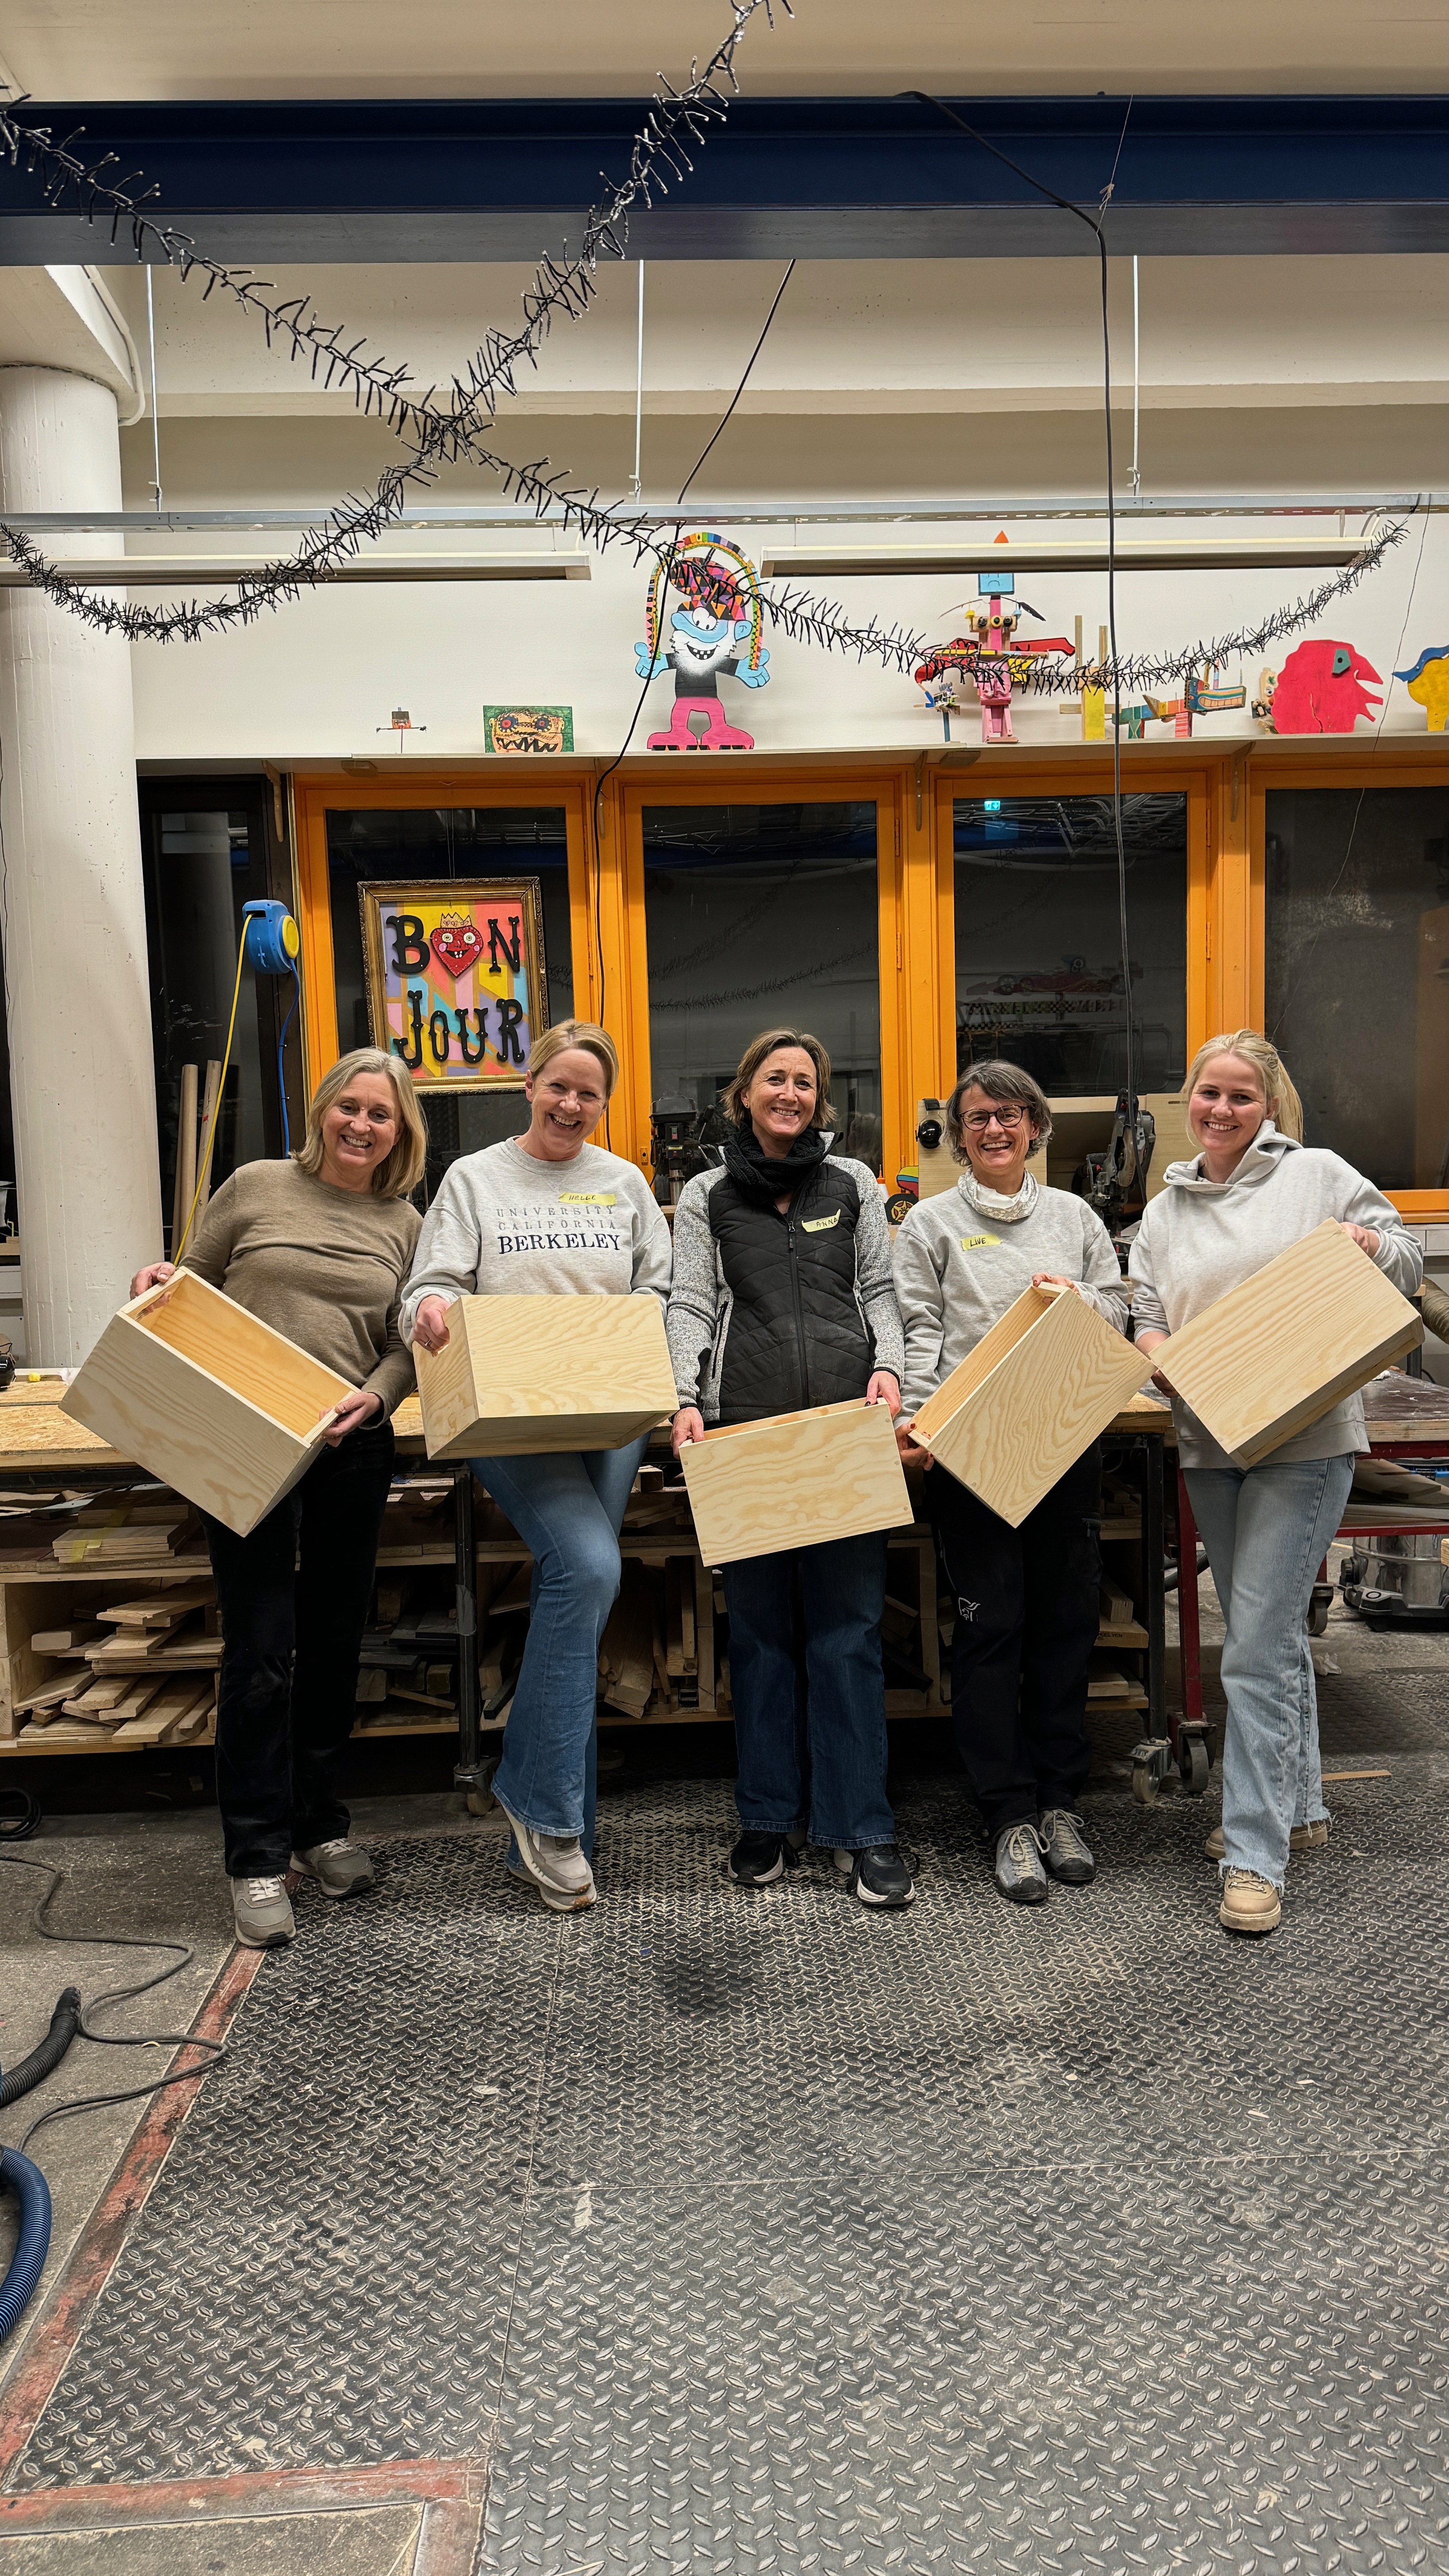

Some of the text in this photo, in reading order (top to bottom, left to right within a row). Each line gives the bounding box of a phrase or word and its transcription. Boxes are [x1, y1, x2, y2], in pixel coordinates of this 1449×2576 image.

[393, 990, 525, 1069] JOUR
[497, 1205, 614, 1217] UNIVERSITY
[498, 1220, 616, 1231] CALIFORNIA
[816, 1216, 838, 1227] ANNE
[497, 1233, 621, 1255] BERKELEY
